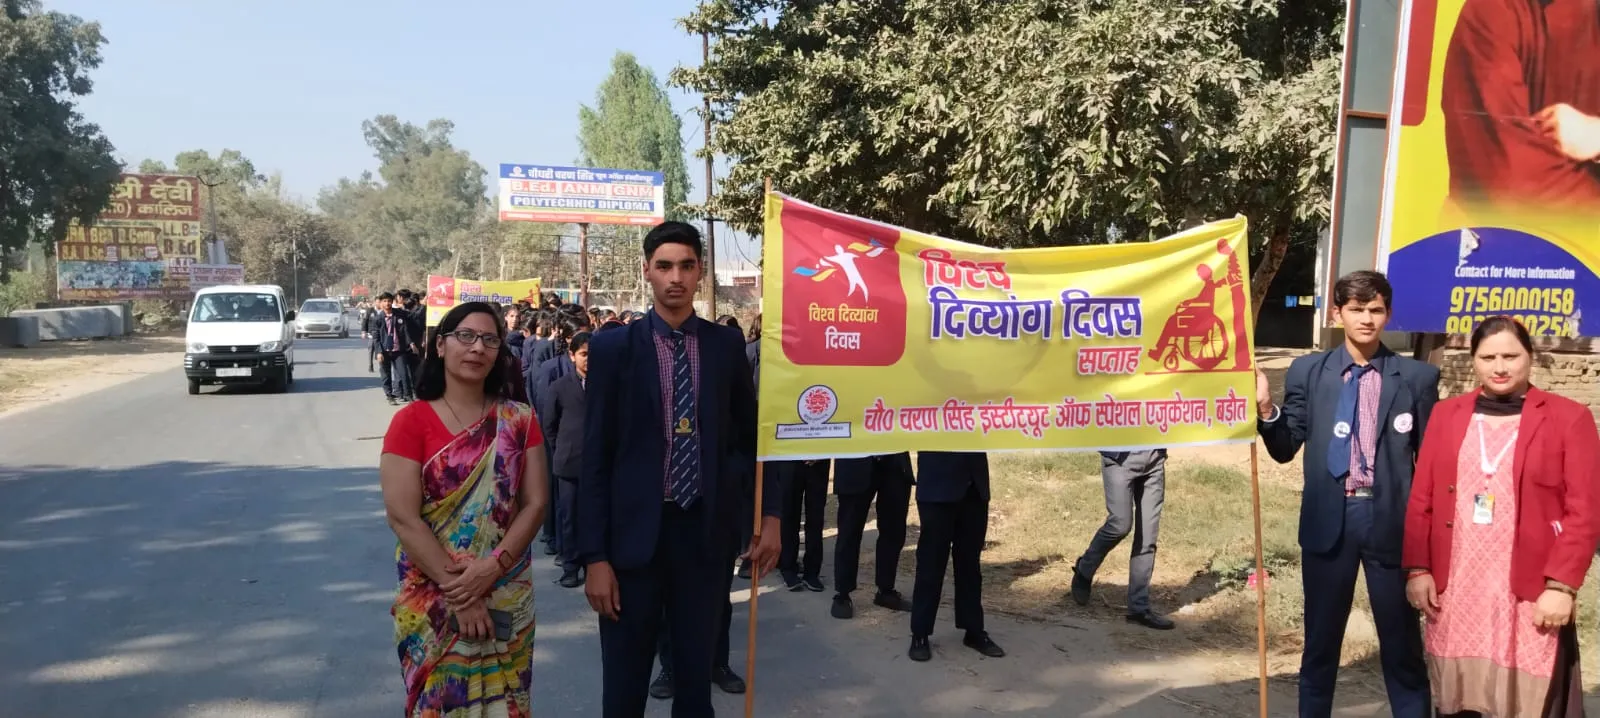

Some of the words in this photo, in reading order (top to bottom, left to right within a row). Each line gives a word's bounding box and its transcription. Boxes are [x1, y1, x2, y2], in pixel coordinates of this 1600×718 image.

[149, 177, 193, 201] देवी
[512, 181, 555, 192] B.Ed.
[563, 183, 606, 195] ANM
[613, 186, 653, 197] GNM
[513, 196, 596, 208] POLYTECHNIC
[600, 200, 651, 211] DIPLOMA
[919, 249, 1011, 290] विश्व
[1455, 265, 1489, 278] Contact
[1490, 265, 1503, 279] for
[1504, 267, 1526, 278] More
[1527, 267, 1575, 279] Information
[928, 286, 1052, 339] दिव्यांग
[1061, 289, 1142, 338] दिवस
[1450, 286, 1575, 315] 9756000158
[808, 303, 835, 322] विश्व
[838, 304, 879, 323] दिव्यांग
[825, 326, 861, 349] दिवस
[1078, 347, 1142, 374] सप्ताह
[900, 407, 939, 431] चरण
[943, 399, 976, 430] सिंह
[1056, 398, 1091, 427] ऑफ
[1096, 394, 1141, 426] स्पेशल
[1145, 392, 1212, 432] एजुकेशन,
[1216, 390, 1247, 426] बड़ौत
